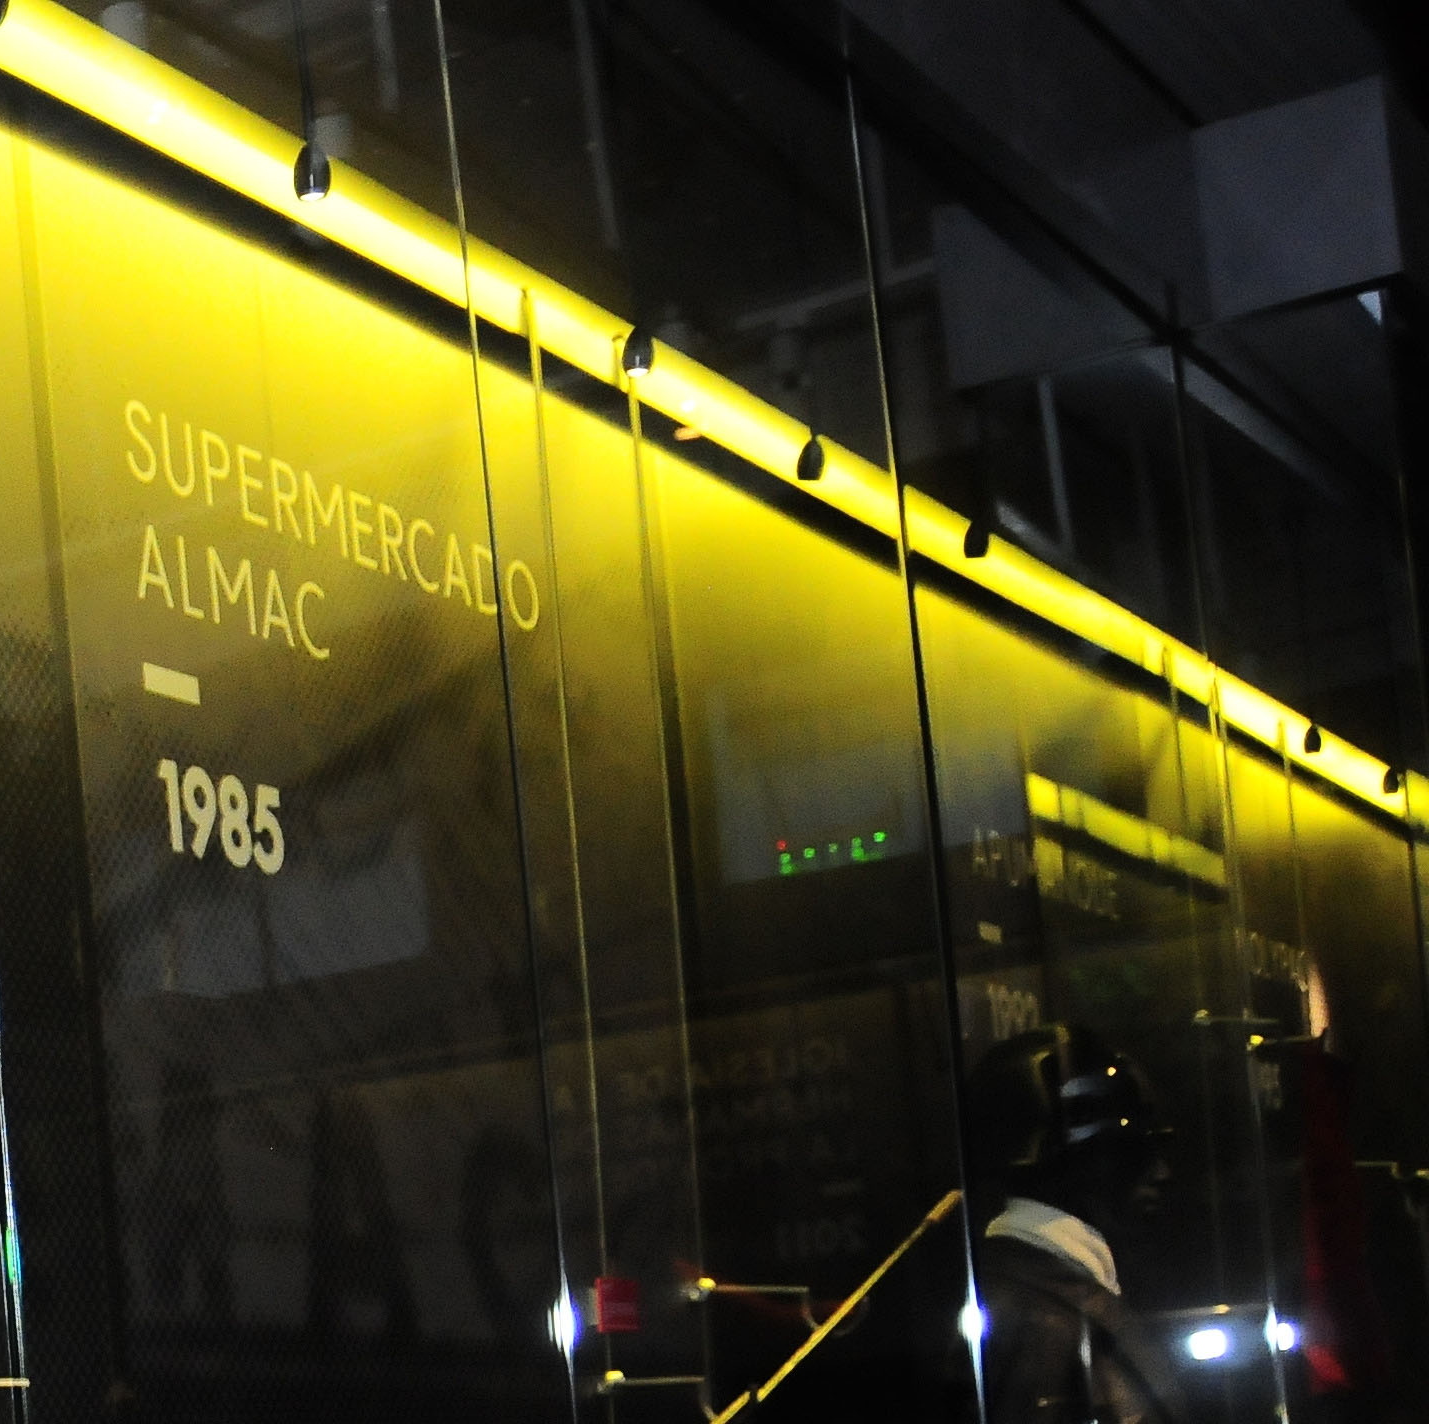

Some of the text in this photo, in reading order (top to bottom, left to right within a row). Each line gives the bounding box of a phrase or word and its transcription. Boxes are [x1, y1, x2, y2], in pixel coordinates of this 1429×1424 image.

[124, 399, 540, 631] SUPERMERCADO
[137, 523, 330, 660] ALMAC
[158, 758, 285, 876] 1985
